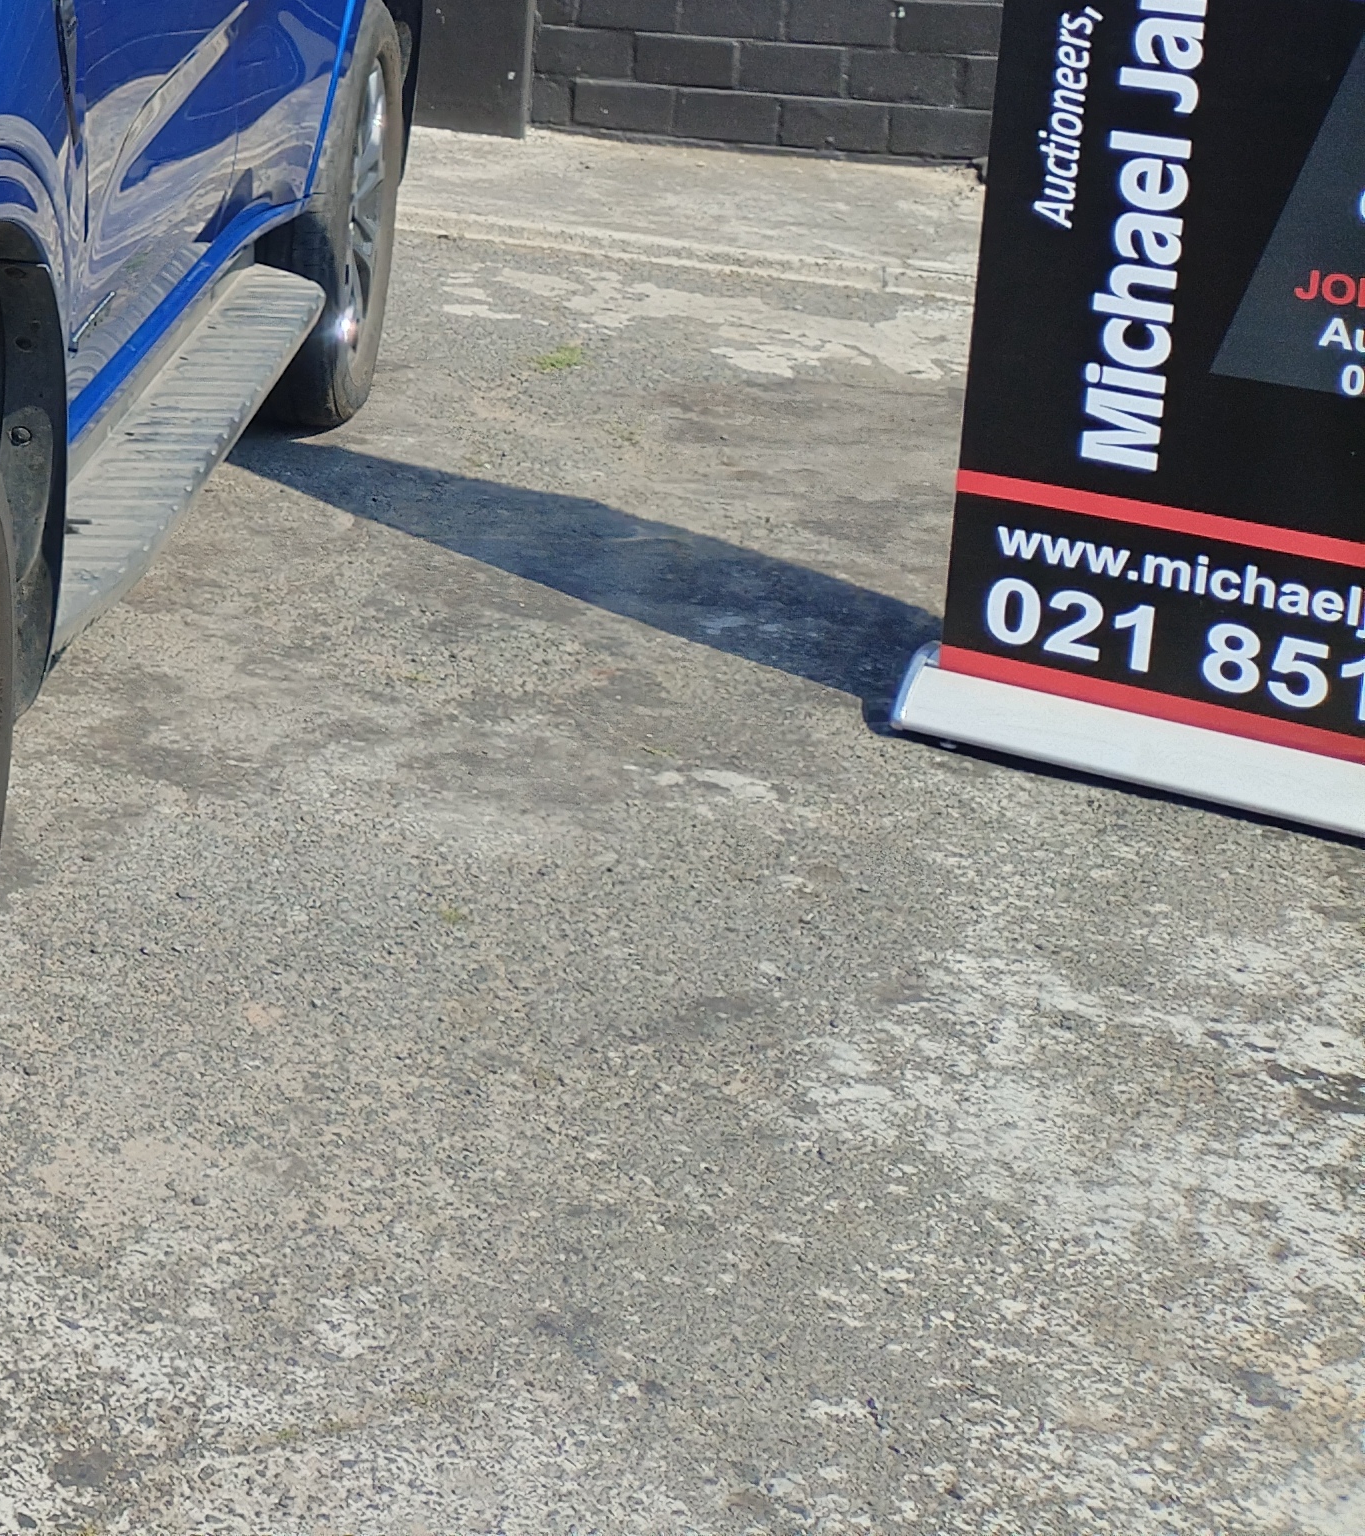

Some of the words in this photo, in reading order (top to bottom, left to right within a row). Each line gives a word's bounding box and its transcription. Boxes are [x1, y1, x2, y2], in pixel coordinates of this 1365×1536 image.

[1033, 5, 1104, 229] Auctioneers,
[1079, 129, 1192, 473] Michael
[986, 576, 1156, 673] 021
[997, 525, 1365, 640] www.michael
